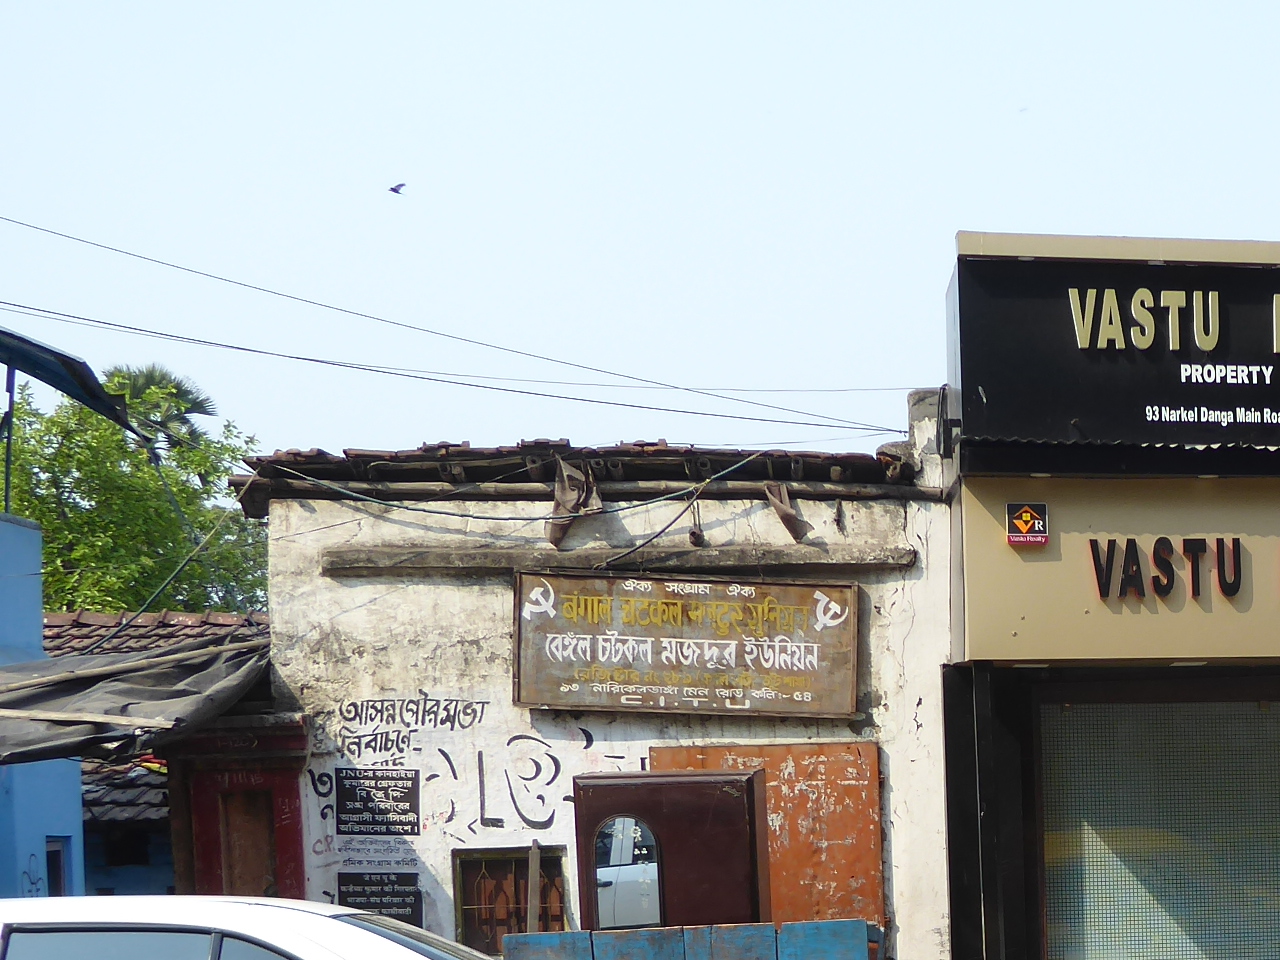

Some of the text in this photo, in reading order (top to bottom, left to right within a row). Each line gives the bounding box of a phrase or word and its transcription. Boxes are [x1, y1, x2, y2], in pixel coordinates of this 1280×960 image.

[1068, 288, 1219, 351] VASTU
[1180, 363, 1274, 385] PROPERTY
[1145, 406, 1160, 421] 93
[1161, 406, 1198, 423] Narkel
[1200, 407, 1234, 427] Danga
[1236, 407, 1261, 423] Main
[1089, 537, 1242, 598] VASTU
[622, 579, 757, 599] ঐক্য সংগ্রাম ঐক্য
[596, 629, 656, 665] চটকল
[339, 698, 396, 726] আসন্ন
